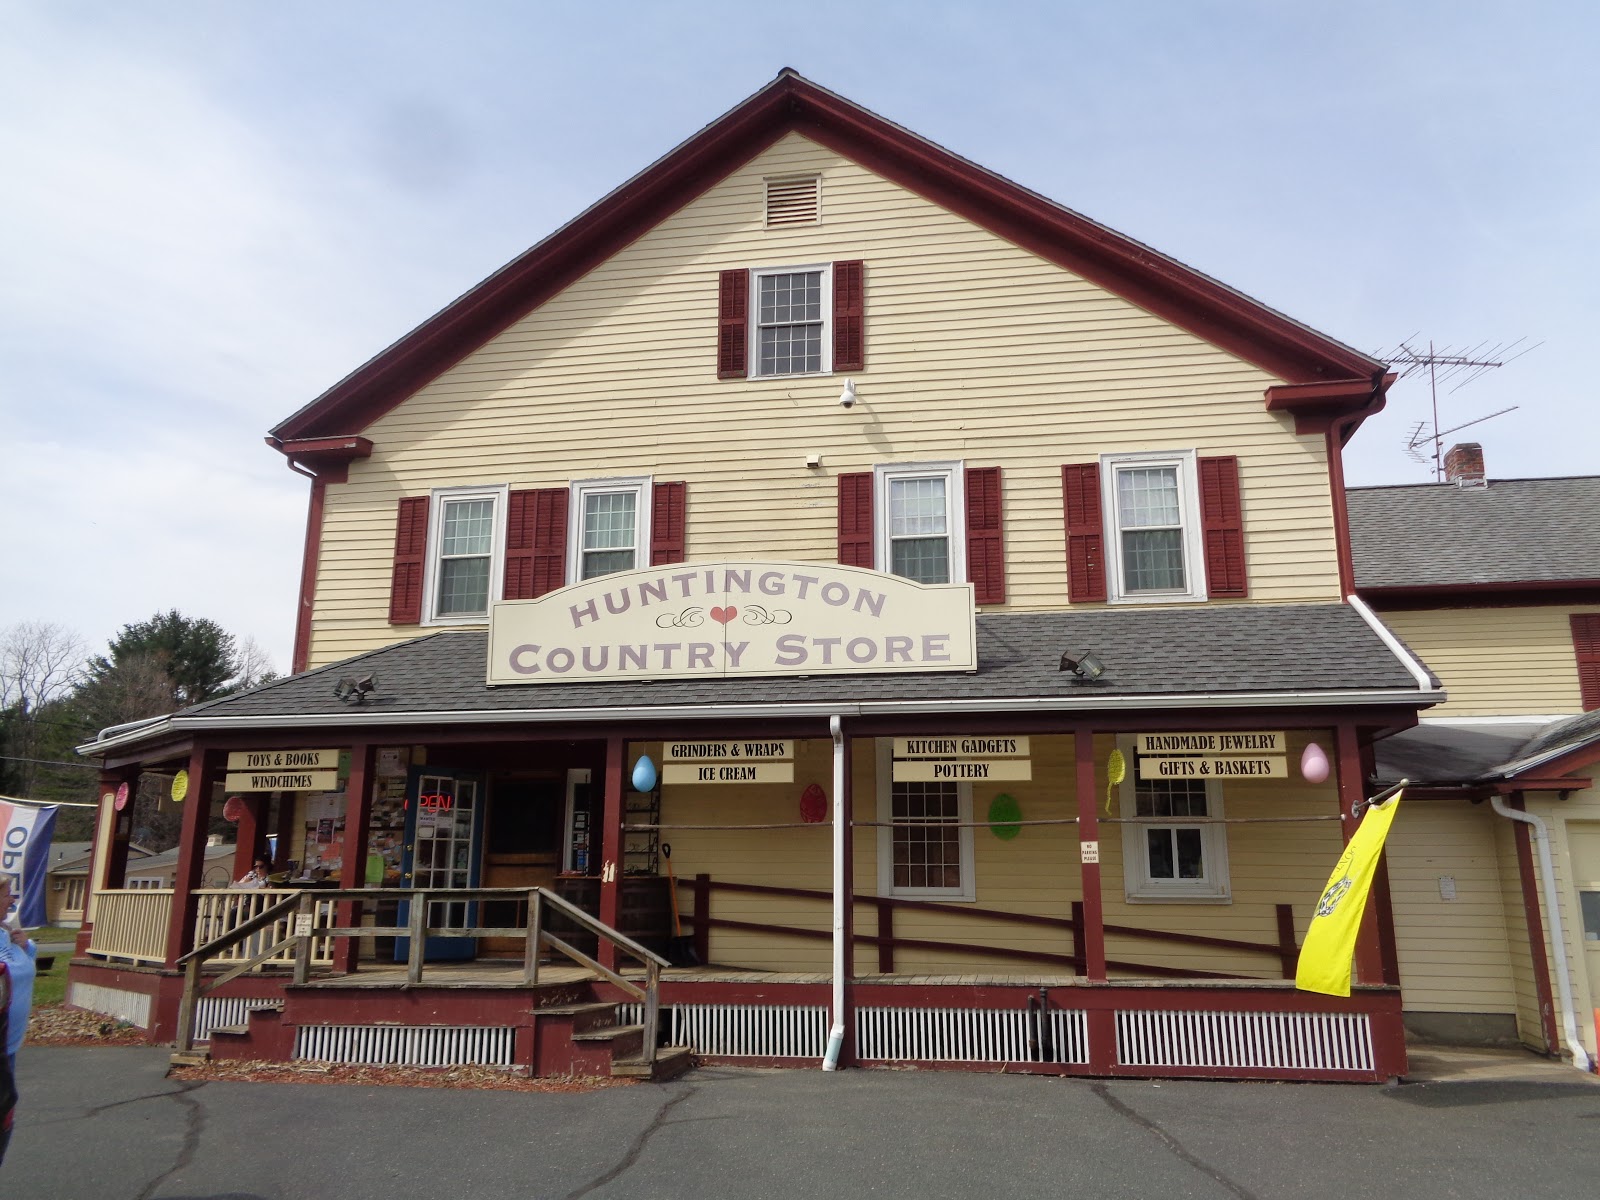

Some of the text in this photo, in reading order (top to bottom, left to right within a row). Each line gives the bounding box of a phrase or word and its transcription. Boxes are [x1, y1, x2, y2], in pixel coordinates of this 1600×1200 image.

[568, 569, 888, 630] HUNTINGTON
[508, 633, 952, 675] COUNTRY STORE
[671, 742, 785, 758] GRINDERS & WRAPS
[907, 739, 1017, 754] KITCHEN GADGETS
[1145, 734, 1276, 751] HANDMADE JEWELRY
[246, 752, 319, 767] TOYS & BOOKS
[698, 766, 757, 781] ICE CREAM
[933, 763, 990, 778] POTTERY
[1159, 760, 1271, 775] GIFTS & BASKETS
[251, 774, 313, 789] WINDCHIMES
